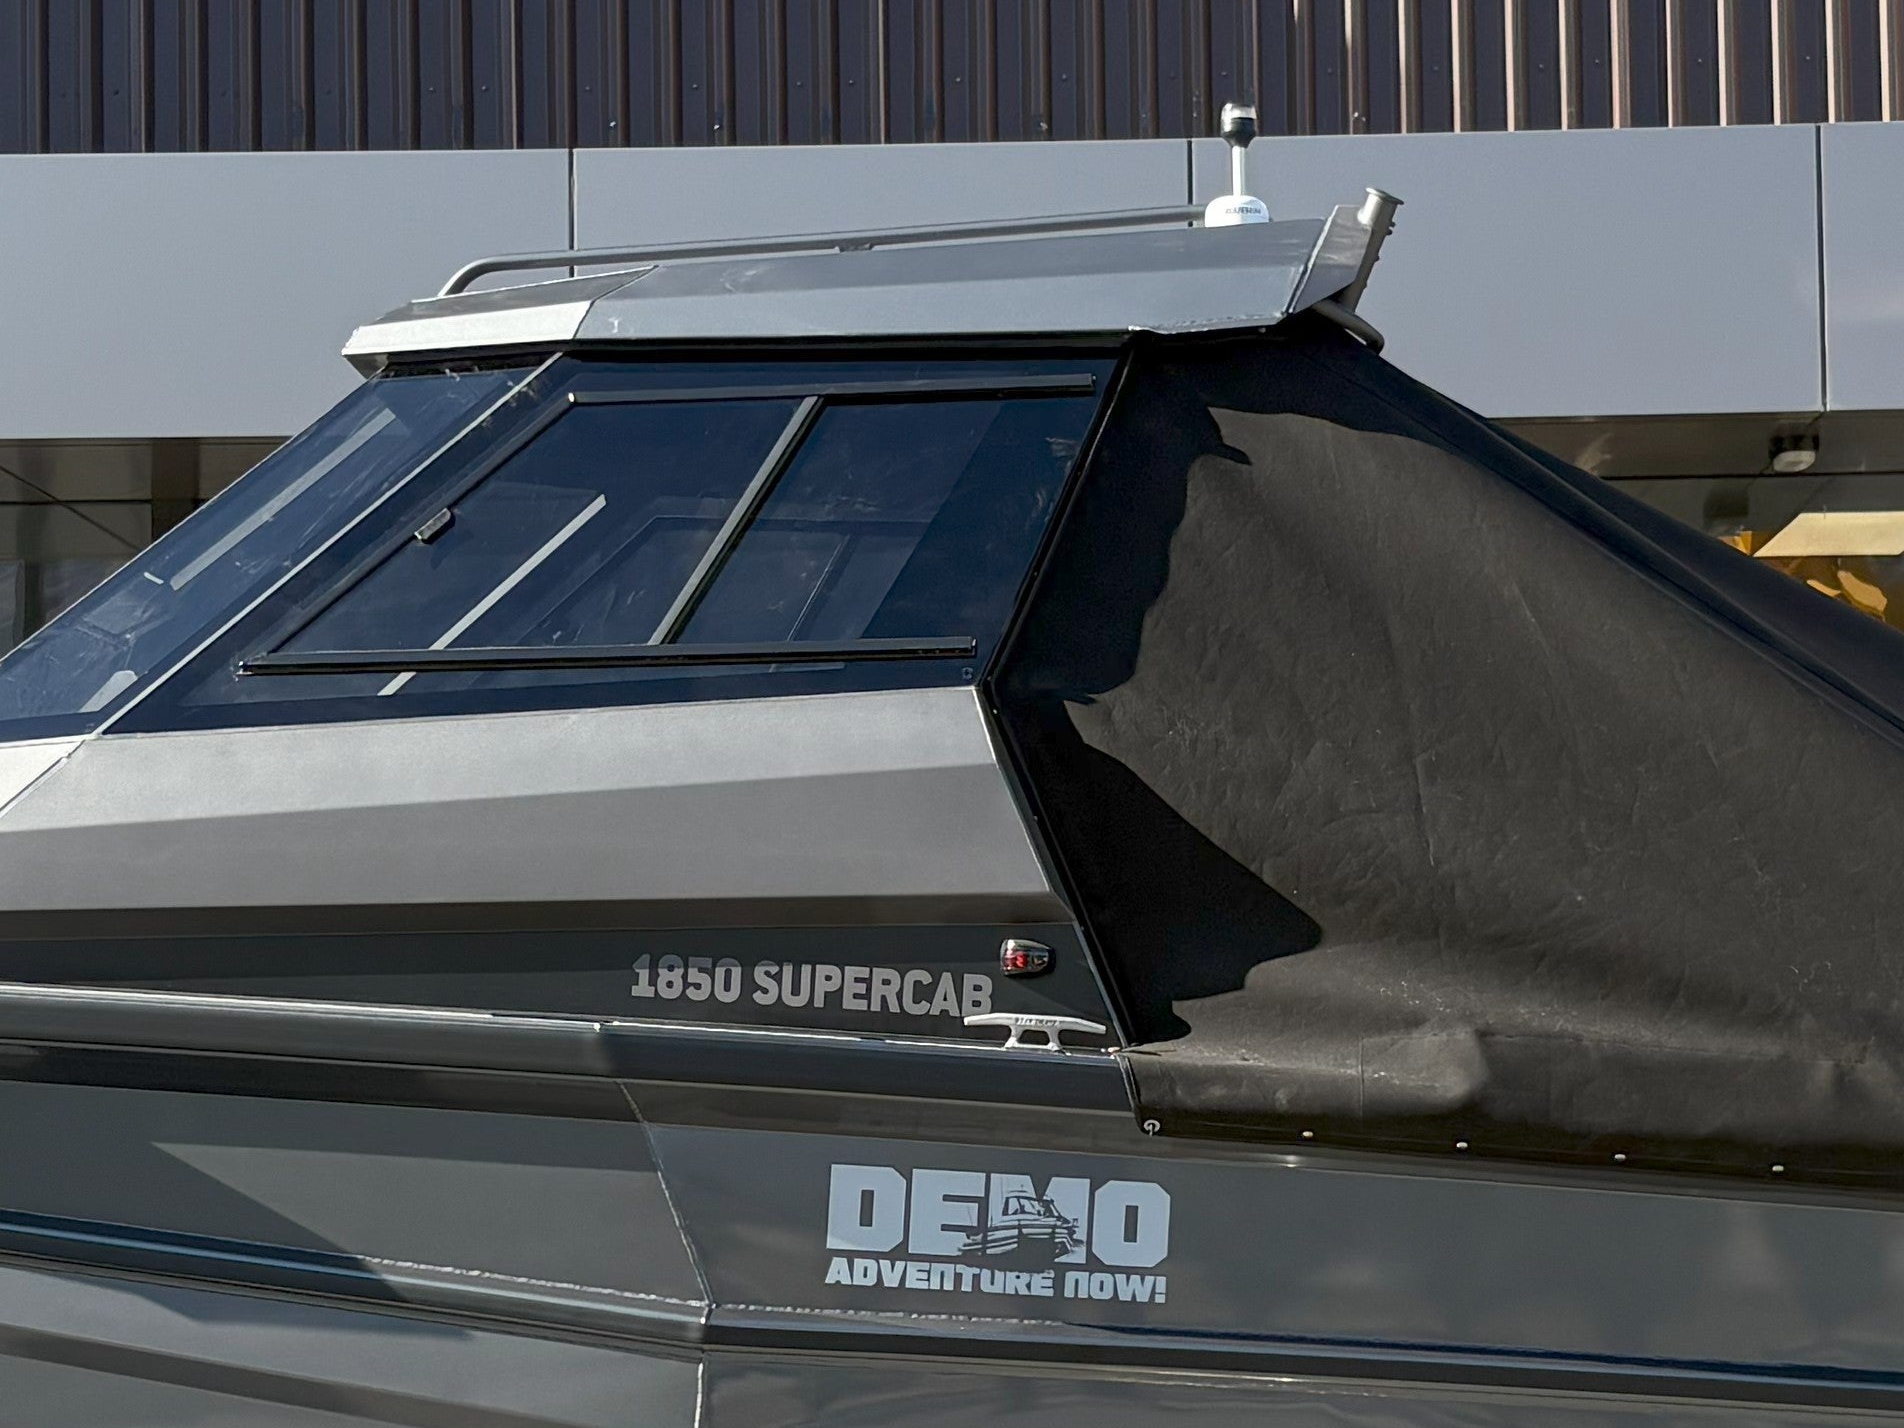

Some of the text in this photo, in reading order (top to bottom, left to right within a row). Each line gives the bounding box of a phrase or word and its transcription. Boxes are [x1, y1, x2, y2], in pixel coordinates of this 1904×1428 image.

[631, 953, 993, 1018] 1850 SUPERCAB
[826, 1163, 1171, 1268] DEMO
[825, 1256, 1167, 1304] ADVENTURE NOW!
